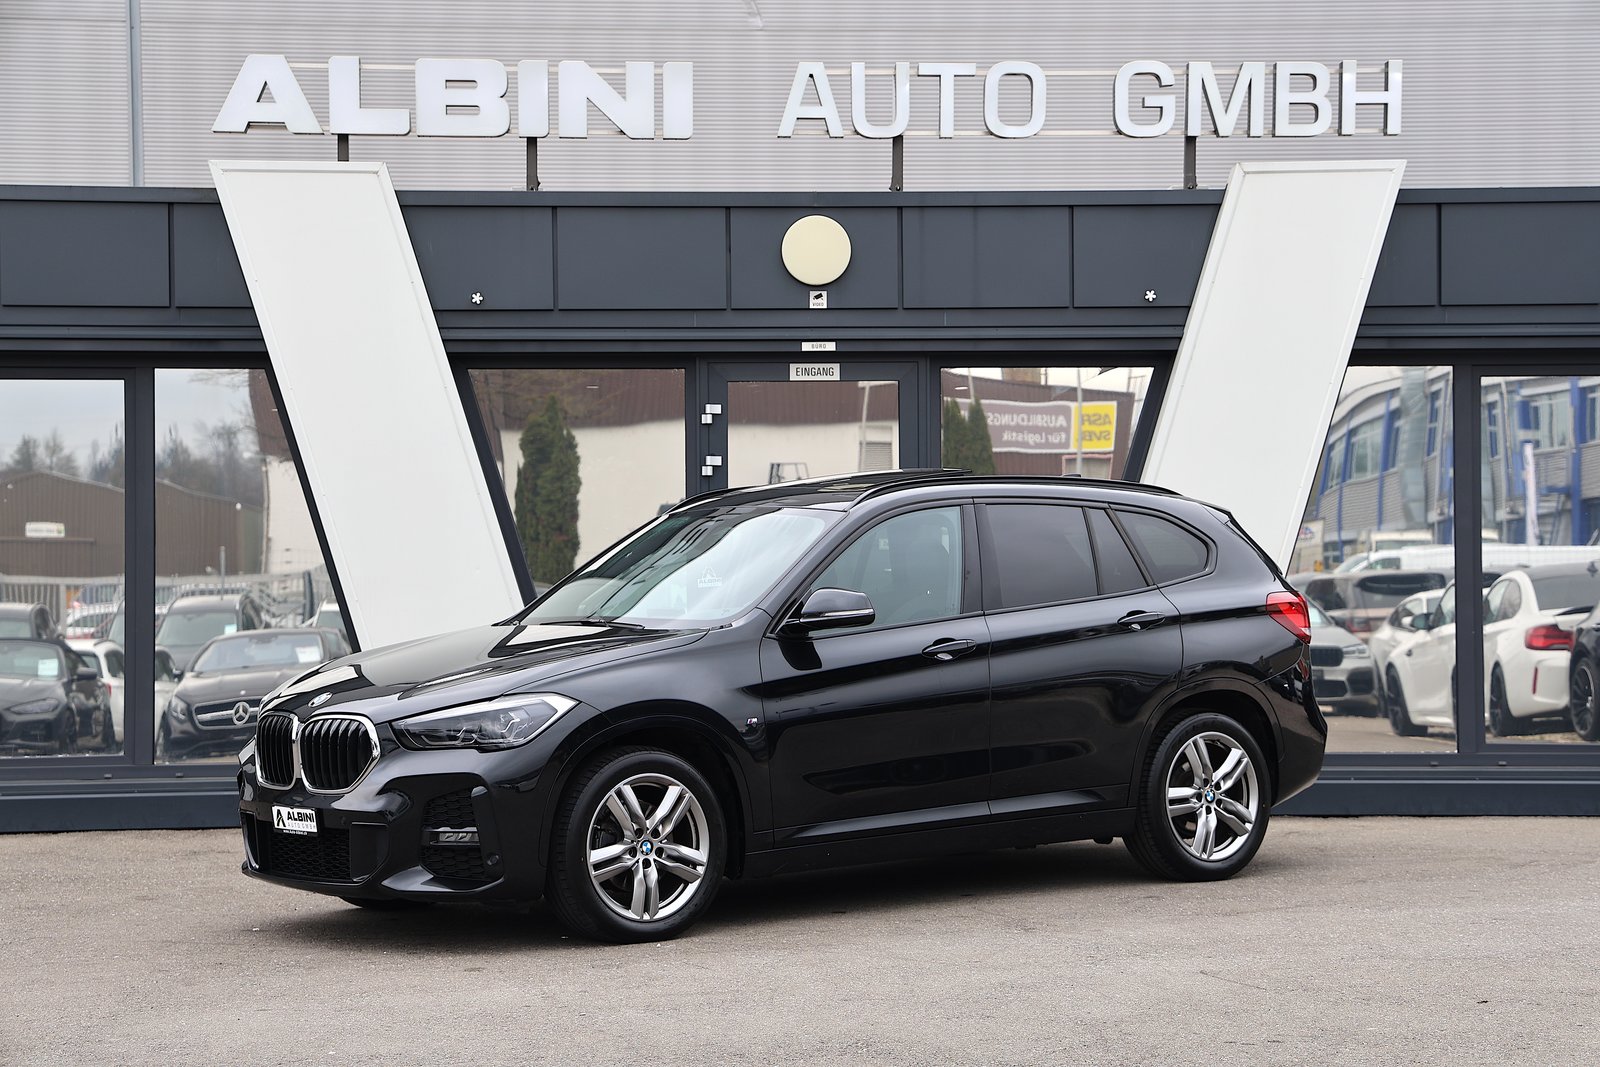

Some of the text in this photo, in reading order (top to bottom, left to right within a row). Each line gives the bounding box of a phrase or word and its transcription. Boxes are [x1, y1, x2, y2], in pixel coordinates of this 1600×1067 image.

[211, 54, 1404, 140] ALBINI AUTO GMBH
[795, 366, 835, 377] EINGANG
[287, 810, 315, 823] ALBINI
